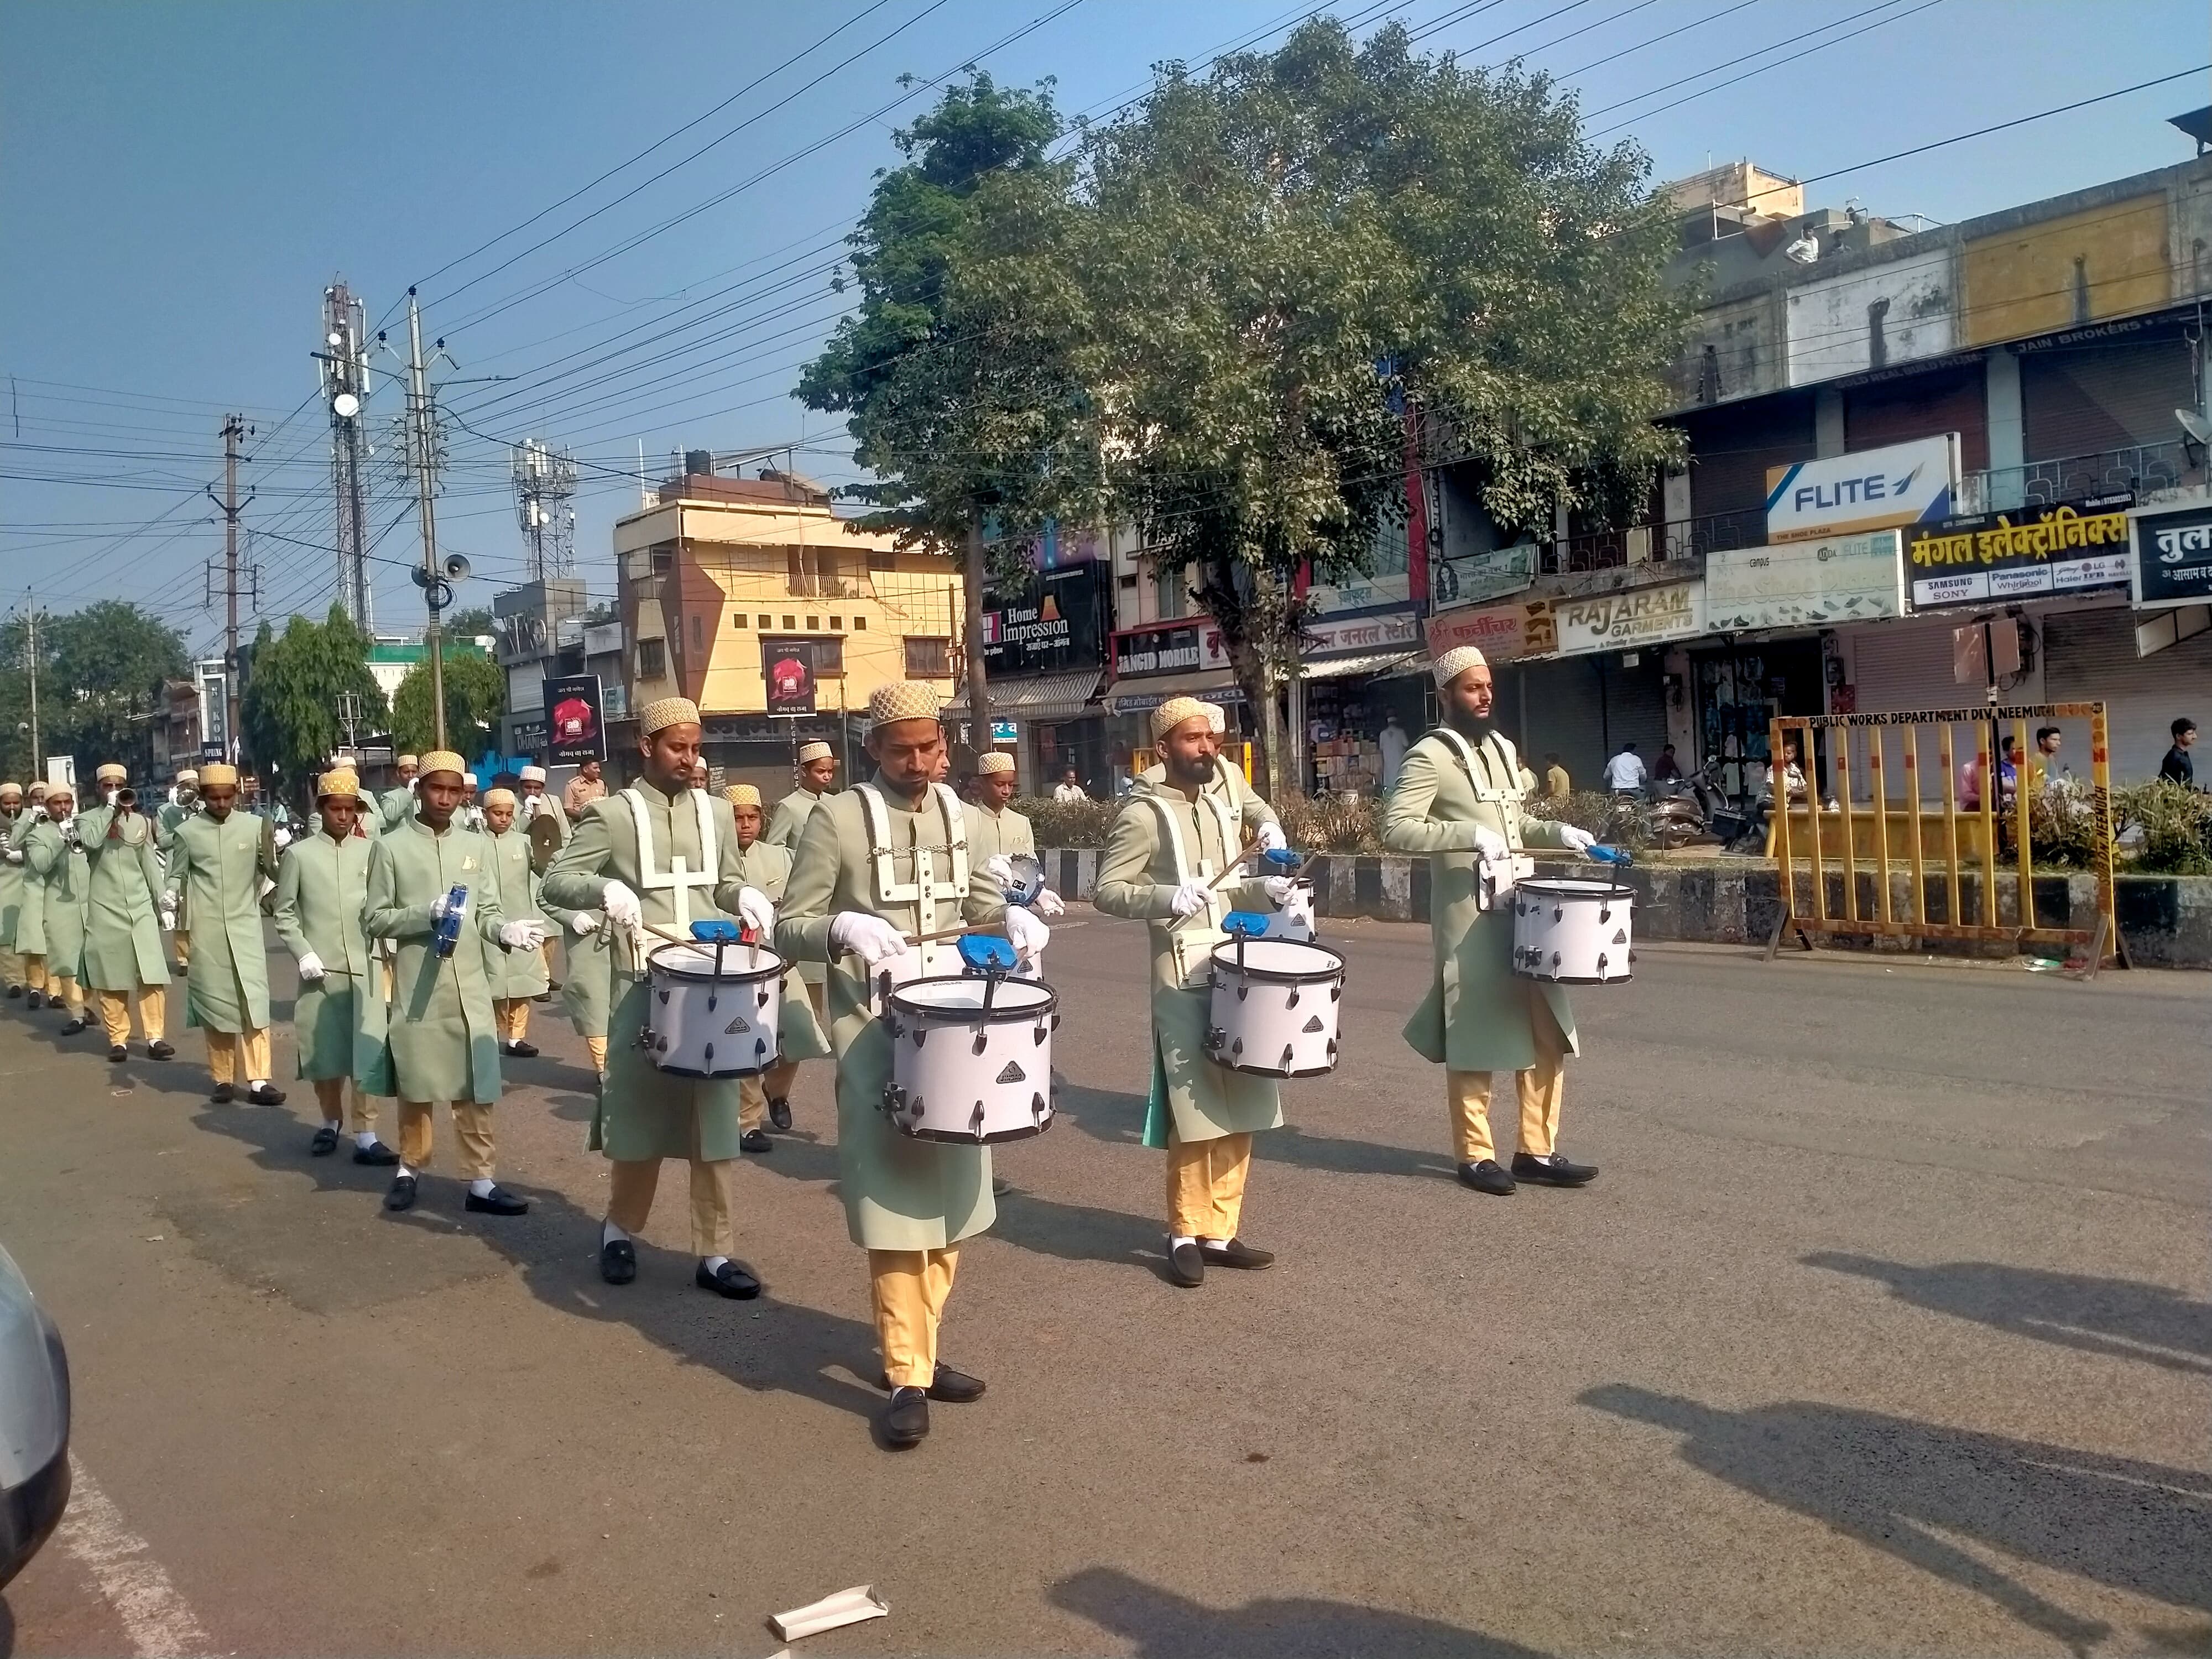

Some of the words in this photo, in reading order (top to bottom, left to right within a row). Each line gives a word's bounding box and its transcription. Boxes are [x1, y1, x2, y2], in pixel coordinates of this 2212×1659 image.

[2017, 338, 2052, 353] JAIN
[2058, 320, 2141, 345] BROKERS
[1795, 474, 1885, 512] FLITE
[1810, 528, 1831, 536] PLAZA
[1911, 530, 1973, 567] मंगल
[1976, 505, 2128, 565] इलेक्ट्रॉनिक्स
[2156, 524, 2212, 564] तुल
[1928, 578, 1973, 589] SAMSUNG
[1992, 568, 2048, 581] Panasonic
[1933, 589, 1968, 600] SONY
[1997, 579, 2042, 593] Whirlpool
[1008, 608, 1038, 624] Home
[1568, 584, 1690, 635] RAJARAM
[1002, 619, 1068, 645] Impression
[1339, 625, 1381, 646] जनरल
[1611, 614, 1693, 637] GARMENTS
[1117, 652, 1157, 674] JANGID
[1159, 646, 1199, 668] MOBILE
[1809, 716, 1844, 728] PUBLIC
[1847, 713, 1887, 726] WORKS
[1891, 709, 1968, 724] DEPARTMENT
[205, 748, 222, 757] SPRING
[2095, 785, 2109, 839] NEEMUCH
